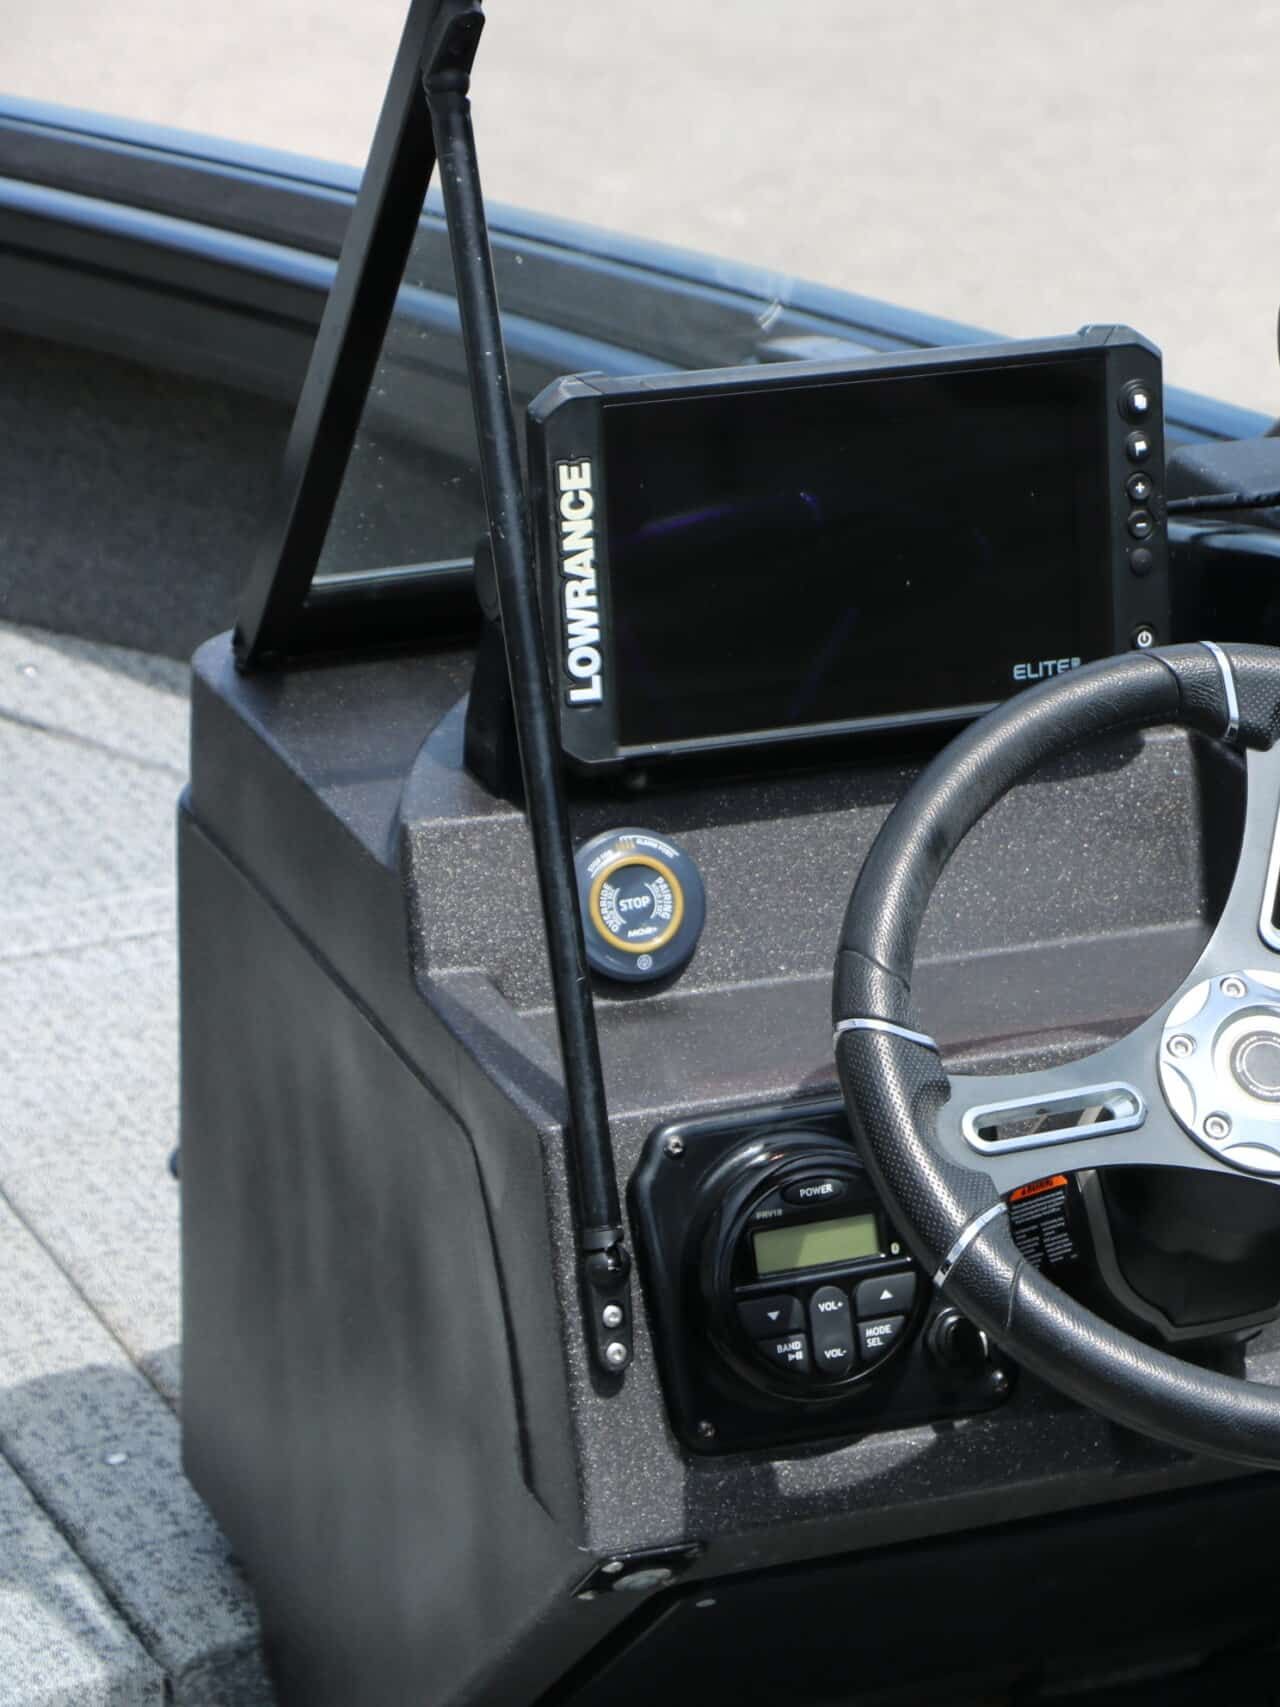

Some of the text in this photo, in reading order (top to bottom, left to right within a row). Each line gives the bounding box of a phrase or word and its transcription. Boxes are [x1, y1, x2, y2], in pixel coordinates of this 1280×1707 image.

[557, 460, 603, 704] LOWRANCE
[619, 896, 651, 912] STOP
[800, 1183, 834, 1199] POWER
[865, 1323, 893, 1338] MODE
[776, 1341, 803, 1354] BAND
[866, 1337, 885, 1349] SEL
